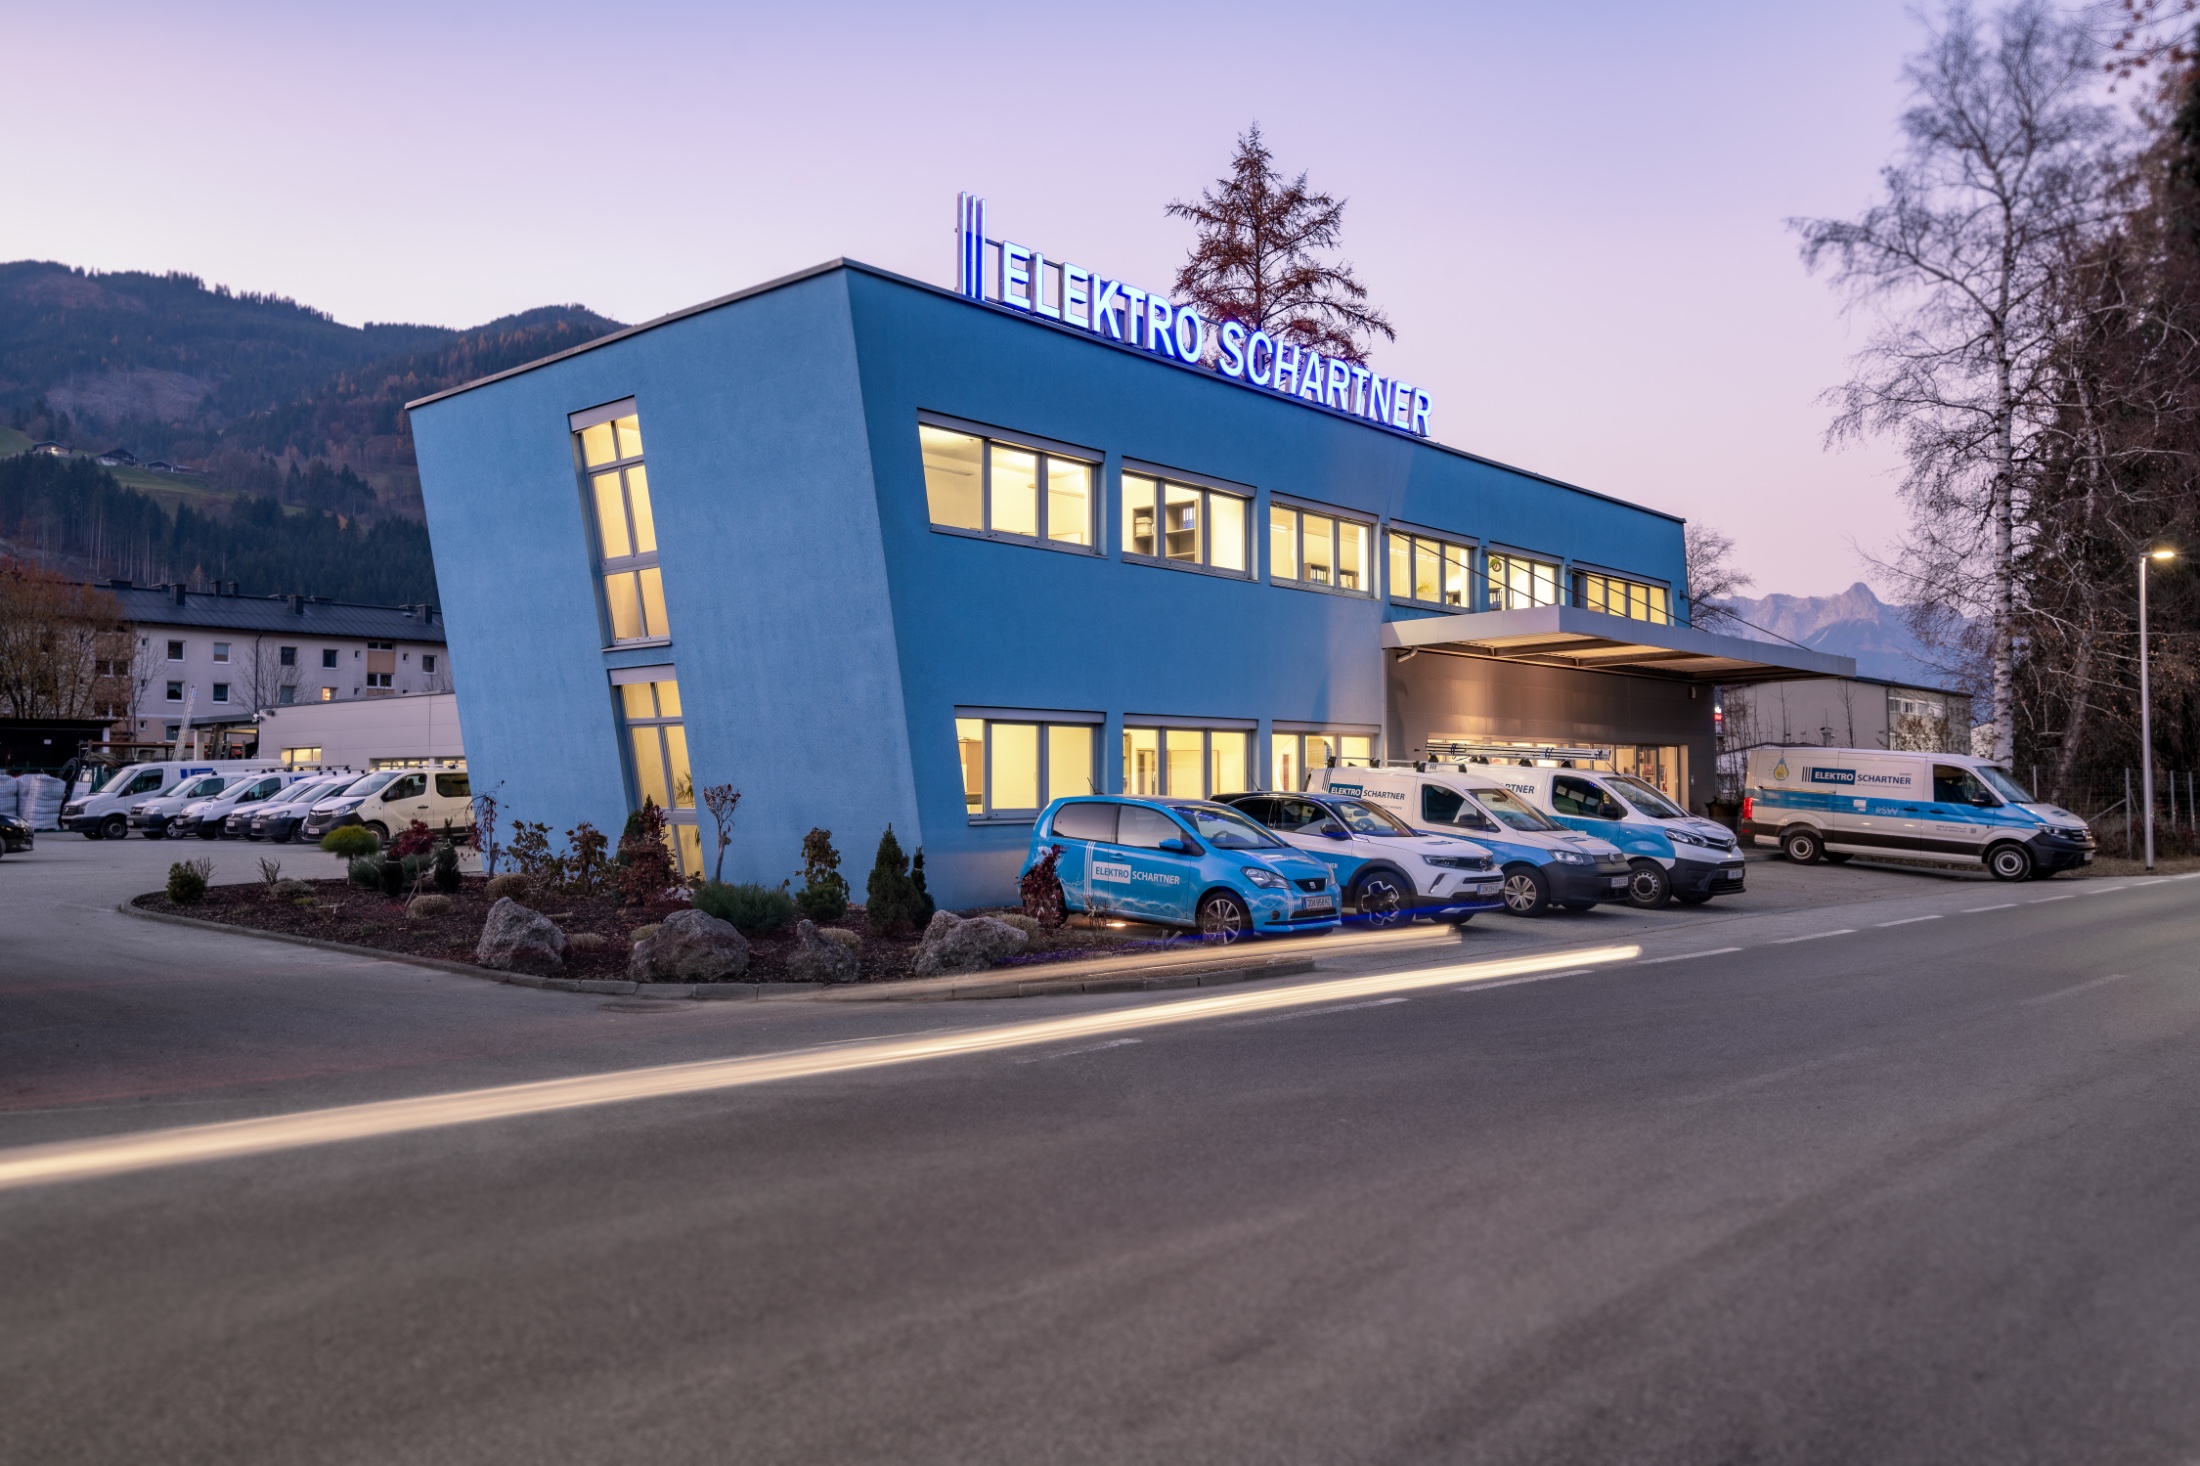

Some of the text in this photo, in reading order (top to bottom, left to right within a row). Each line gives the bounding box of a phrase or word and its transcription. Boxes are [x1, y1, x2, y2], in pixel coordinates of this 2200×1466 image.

[1001, 240, 1433, 437] ELEKTRO SCHARTNER
[1815, 771, 1854, 781] ELEKTRO
[1857, 774, 1912, 785] SCHARTNER
[1331, 786, 1406, 801] ELEKTRO SCHARTNER
[1095, 866, 1180, 885] ELEKTRO SCHARTNER
